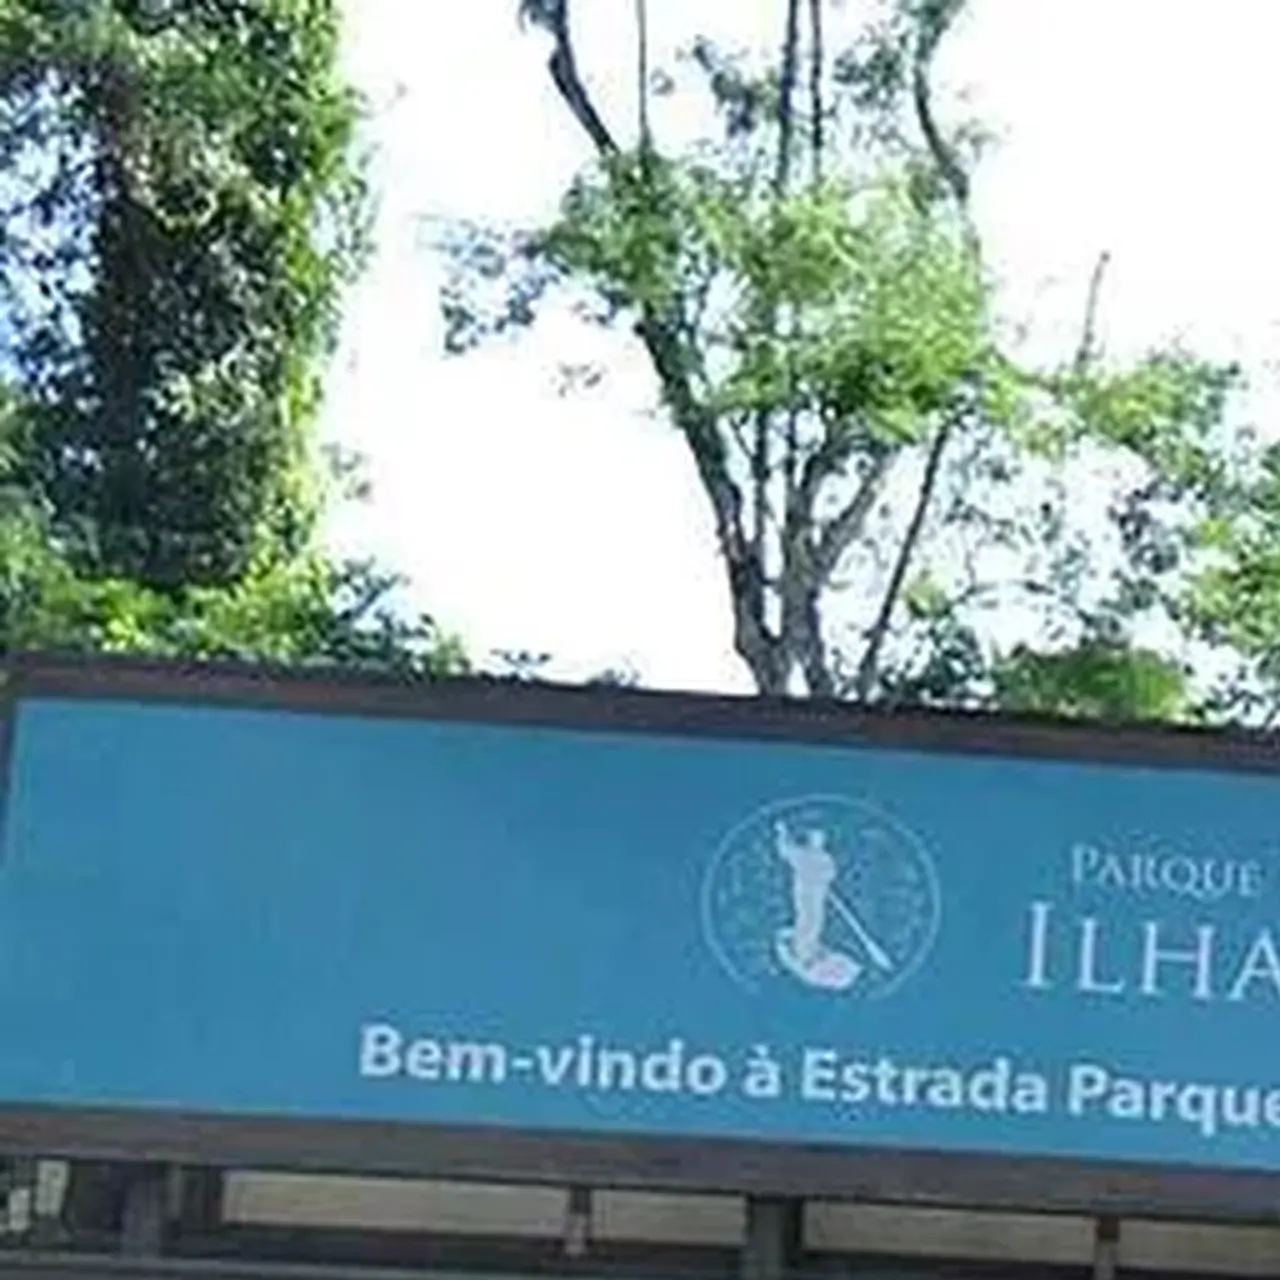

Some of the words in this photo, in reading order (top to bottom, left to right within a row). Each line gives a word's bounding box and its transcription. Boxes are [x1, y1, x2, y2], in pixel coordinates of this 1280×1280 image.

[1071, 842, 1263, 898] PARQUE
[360, 1022, 728, 1095] Bem-vindo
[743, 1047, 783, 1099] à
[803, 1049, 1048, 1115] Estrada
